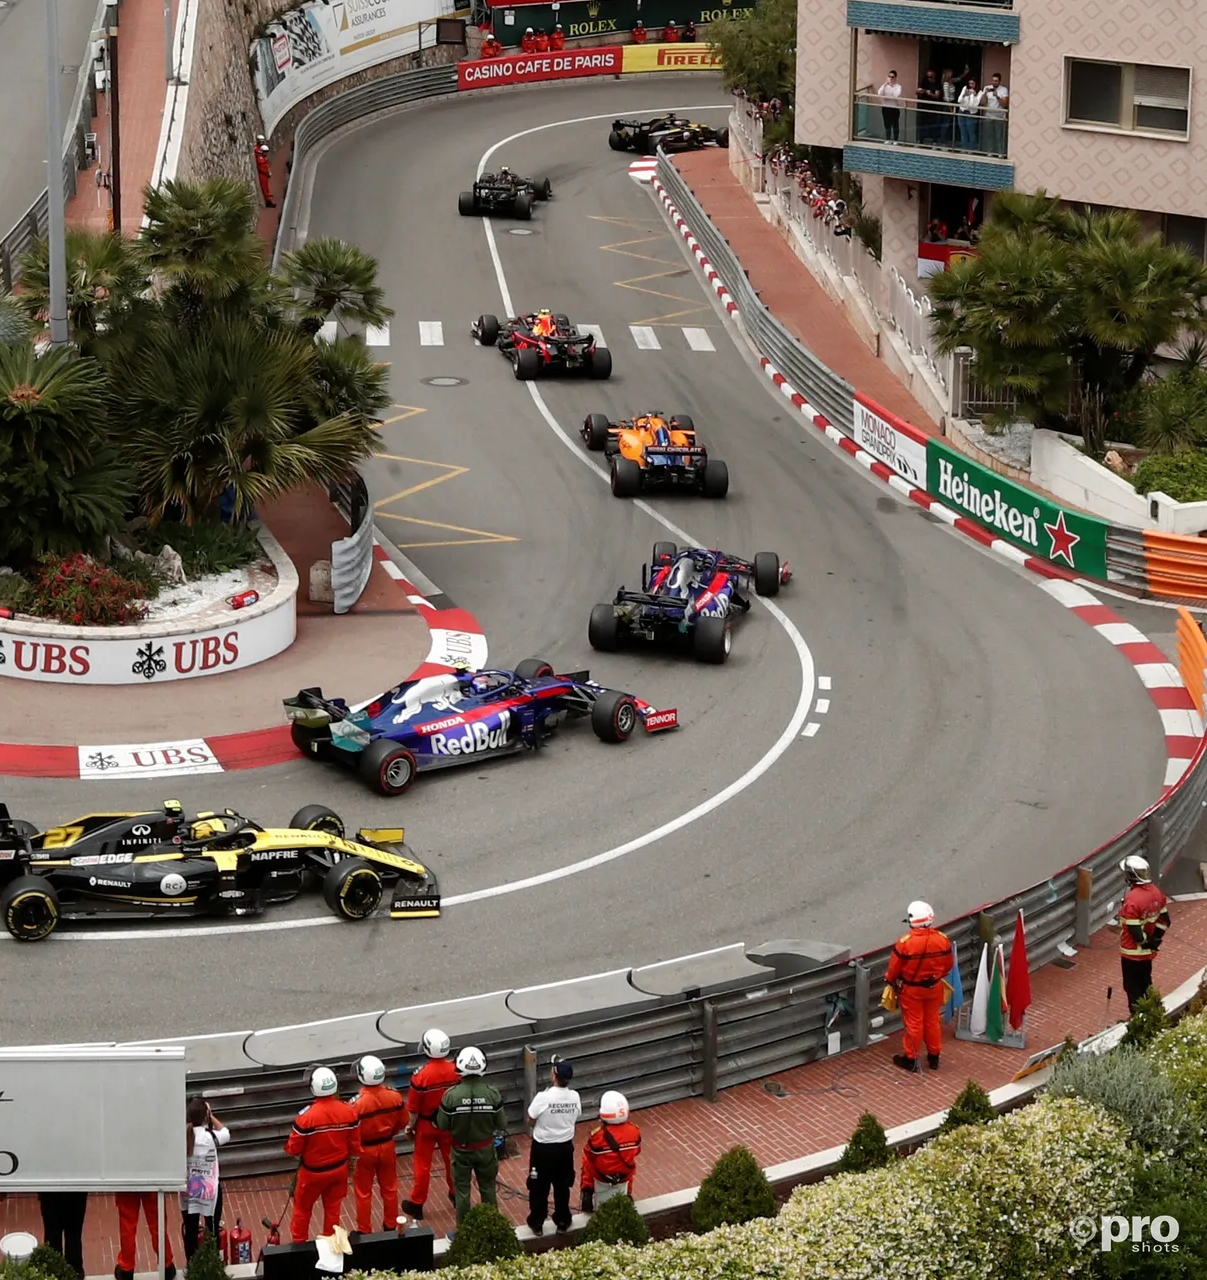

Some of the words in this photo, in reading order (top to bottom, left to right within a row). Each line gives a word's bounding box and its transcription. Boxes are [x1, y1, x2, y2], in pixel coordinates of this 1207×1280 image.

[351, 7, 387, 28] ASSURANCES
[569, 18, 618, 37] ROLEX
[465, 62, 513, 82] CASINO
[515, 58, 551, 76] CAFE
[553, 56, 572, 71] DE
[575, 53, 615, 69] PARIS
[861, 408, 897, 449] MONACO
[938, 458, 1039, 547] Heineken
[173, 631, 240, 674] UBS
[446, 631, 473, 655] UBS
[12, 639, 91, 676] UBS
[421, 717, 466, 734] HONDA
[646, 712, 676, 727] TENNOR
[129, 746, 210, 767] UBS
[43, 826, 85, 849] 27
[122, 837, 162, 846] INFINITI
[77, 856, 99, 865] Castrol
[99, 853, 134, 864] EDGE
[251, 850, 299, 862] MAPFRE
[97, 879, 133, 888] RENAULT
[395, 899, 439, 908] RENAULT
